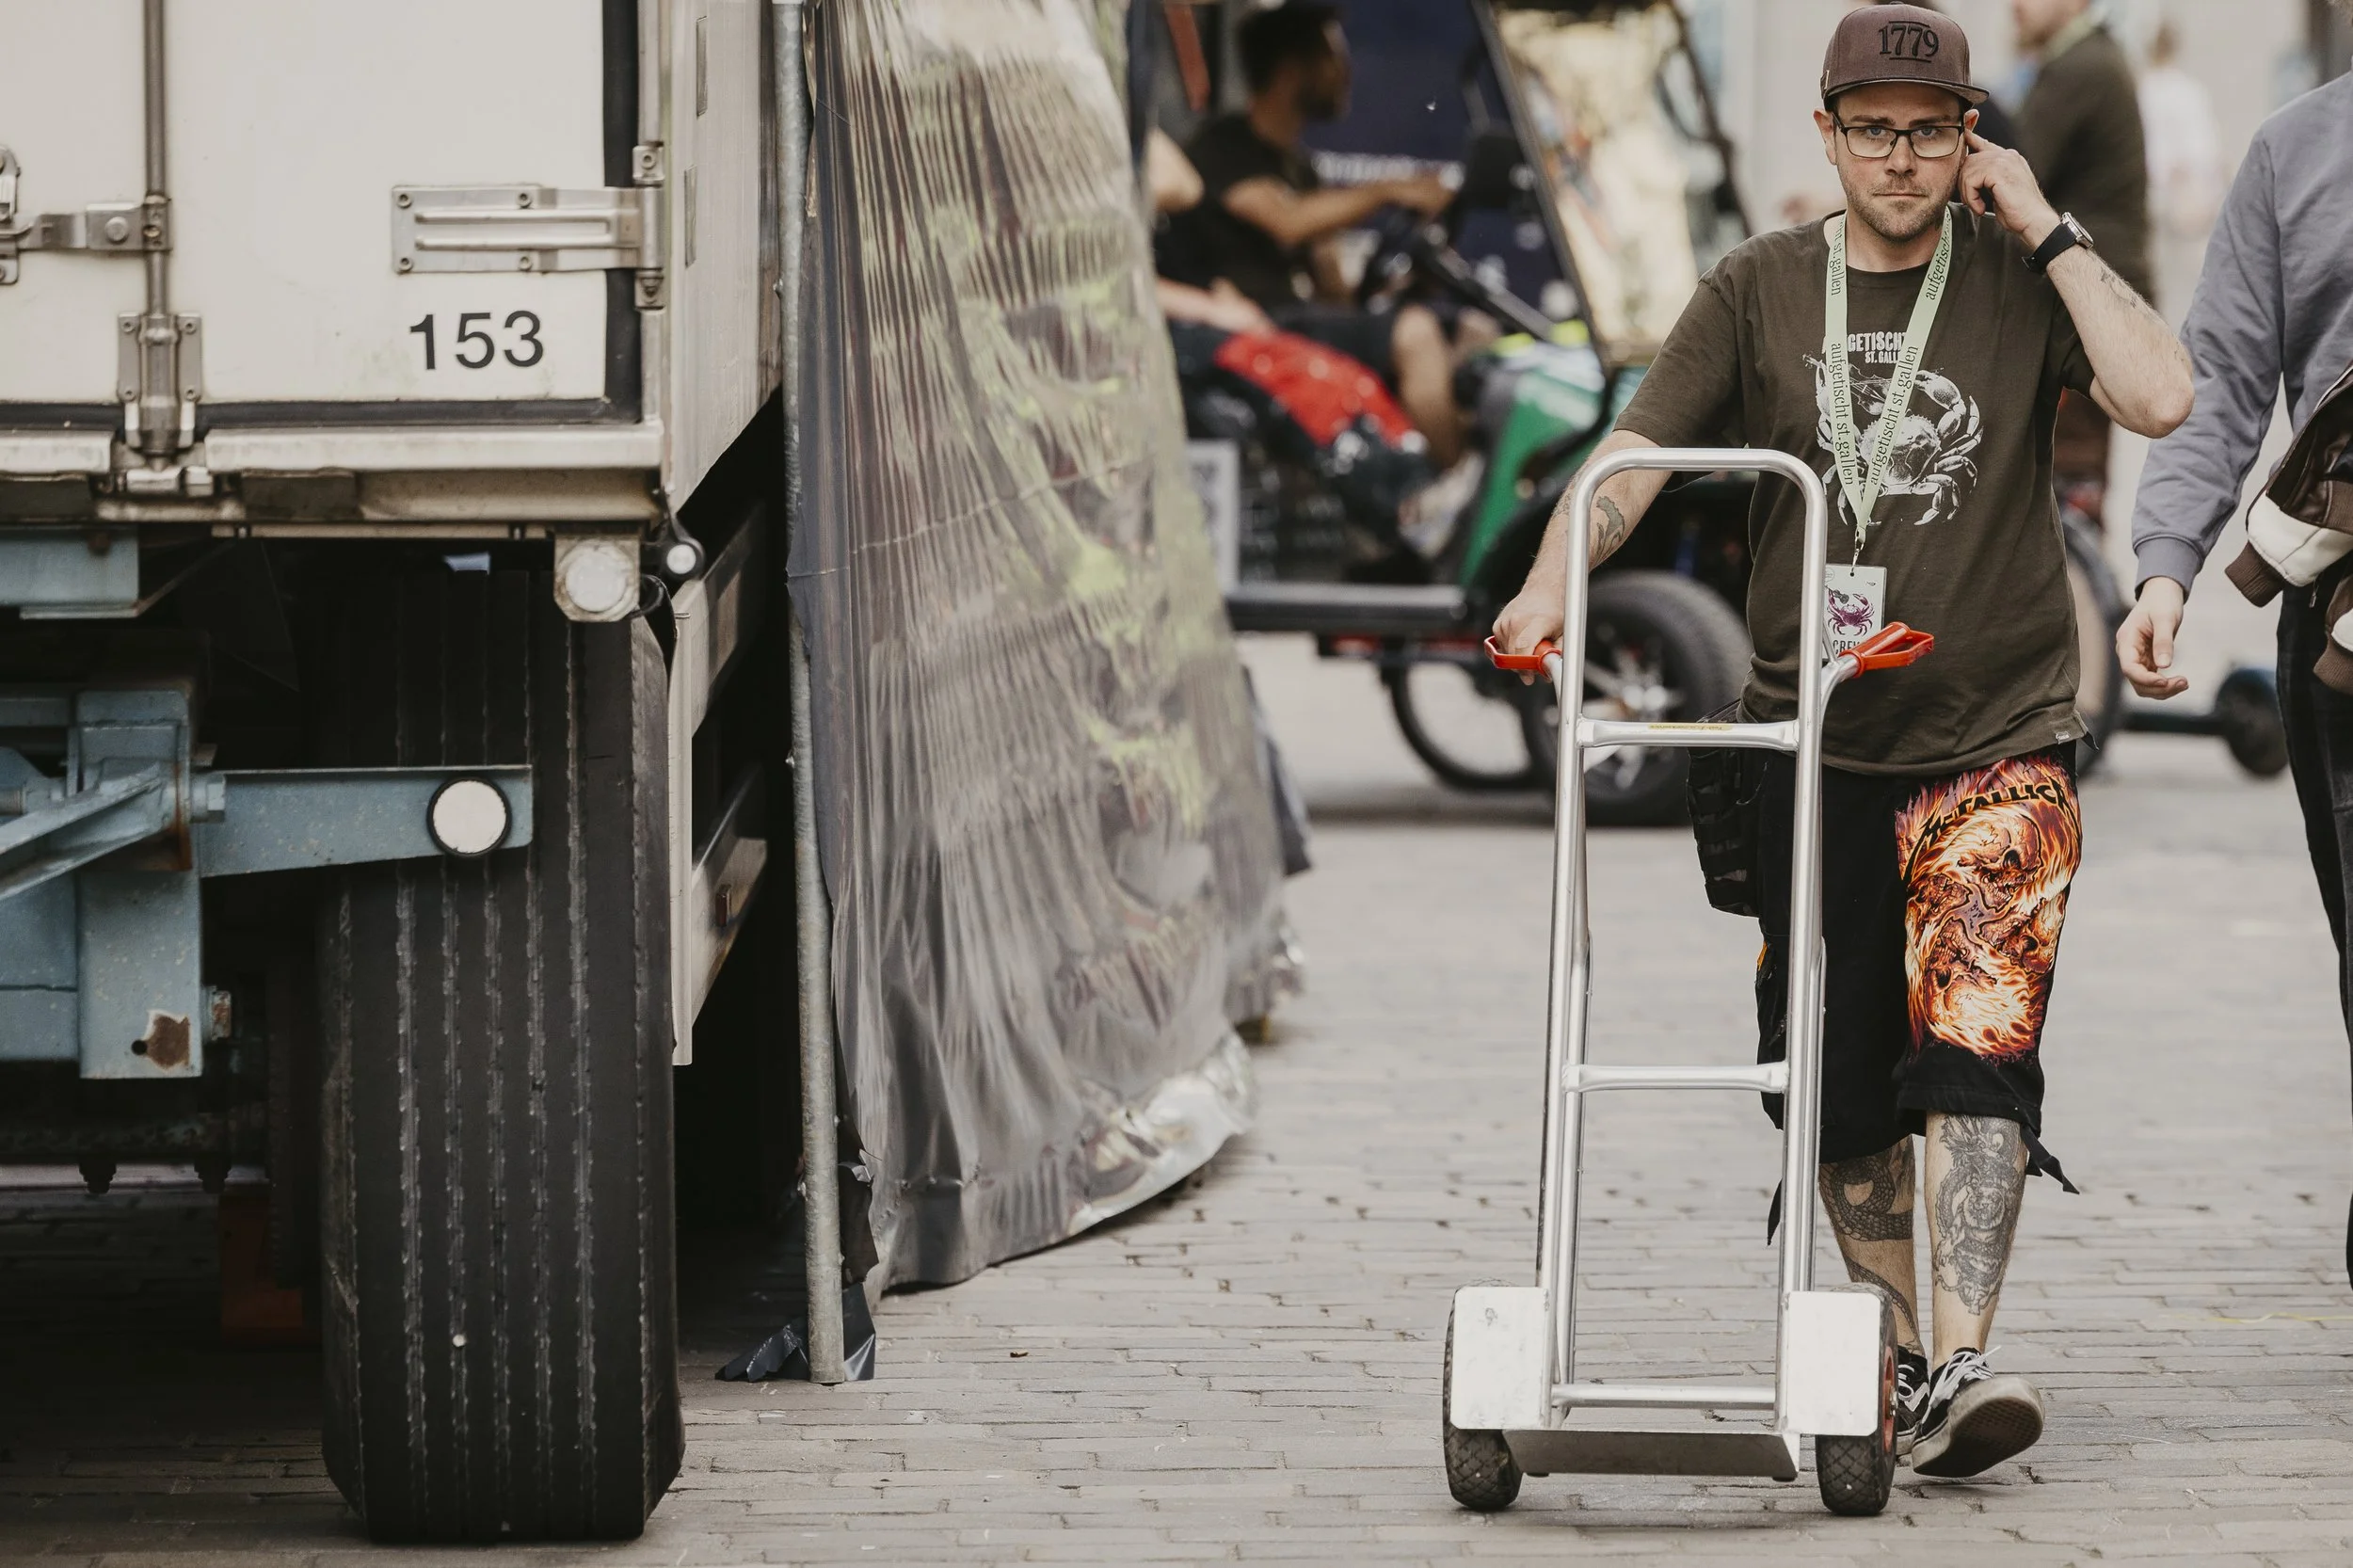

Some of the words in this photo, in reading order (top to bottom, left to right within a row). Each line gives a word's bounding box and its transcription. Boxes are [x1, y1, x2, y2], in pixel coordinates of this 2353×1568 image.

[1878, 24, 1939, 57] 1779
[409, 310, 544, 370] 153
[1829, 343, 1850, 419] aufgetischt
[1870, 408, 1900, 486] aufgetischt
